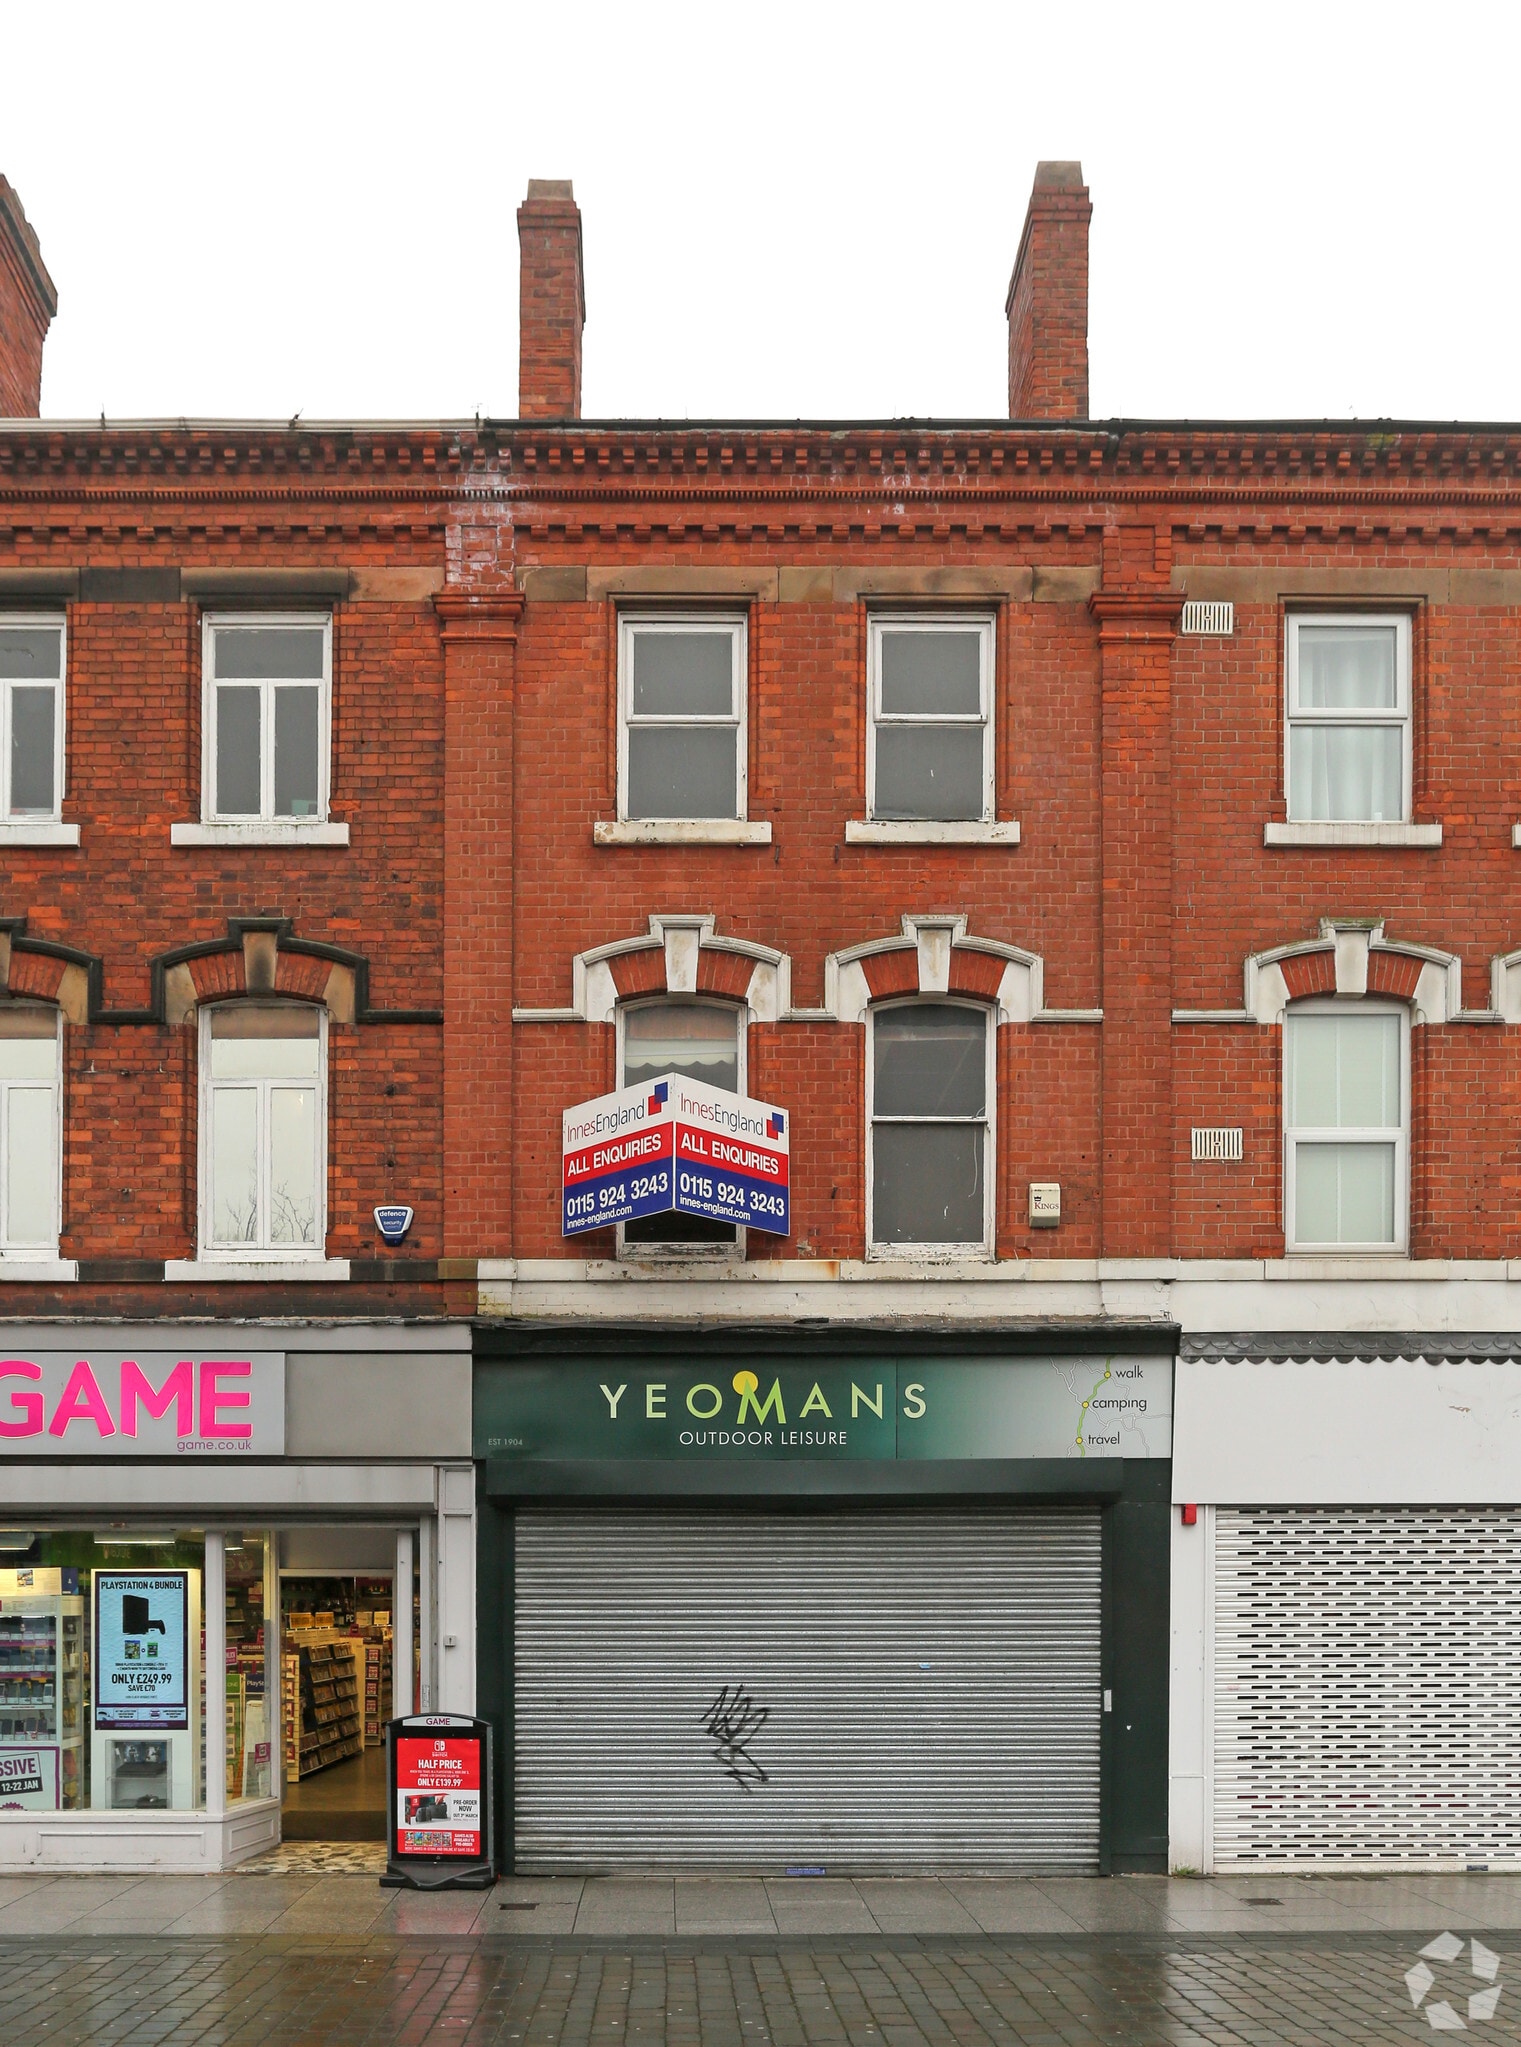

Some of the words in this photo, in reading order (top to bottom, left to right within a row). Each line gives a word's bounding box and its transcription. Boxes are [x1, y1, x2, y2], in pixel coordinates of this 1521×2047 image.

[568, 1098, 645, 1143] InnesEngland
[681, 1093, 764, 1136] InnesEngland
[567, 1156, 590, 1177] ALL
[593, 1133, 662, 1169] ENQUIRIES
[681, 1132, 708, 1155] ALL
[712, 1140, 779, 1175] ENQUIRIES
[567, 1192, 595, 1217] 0115
[599, 1184, 626, 1208] 924
[631, 1172, 668, 1200] 3243
[680, 1173, 713, 1198] 0115
[717, 1182, 746, 1206] 924
[749, 1191, 785, 1217] 3243
[680, 1194, 751, 1221] innes-england.com
[567, 1205, 633, 1229] innes-england.com
[1116, 1365, 1144, 1378] walk
[0, 1359, 254, 1439] GAME
[599, 1376, 927, 1426] YEOMANS
[1092, 1399, 1147, 1412] camping
[176, 1438, 252, 1453] game.co.uk
[488, 1438, 501, 1446] EST
[504, 1438, 523, 1446] 1904
[679, 1431, 773, 1446] OUTDOOR
[781, 1431, 847, 1446] LEISURE
[1088, 1431, 1120, 1445] travel
[101, 1581, 149, 1590] PLAYSTATION
[149, 1581, 154, 1590] 4
[154, 1581, 183, 1590] BUNDLE
[345, 1614, 354, 1622] PC
[111, 1673, 135, 1684] ONLY
[136, 1673, 172, 1684] £249.99
[426, 1717, 451, 1725] GAME
[418, 1759, 438, 1769] HALF
[439, 1759, 463, 1769] PRICE
[1, 1781, 22, 1792] 12-22
[23, 1780, 39, 1790] JAN
[417, 1778, 435, 1786] ONLY
